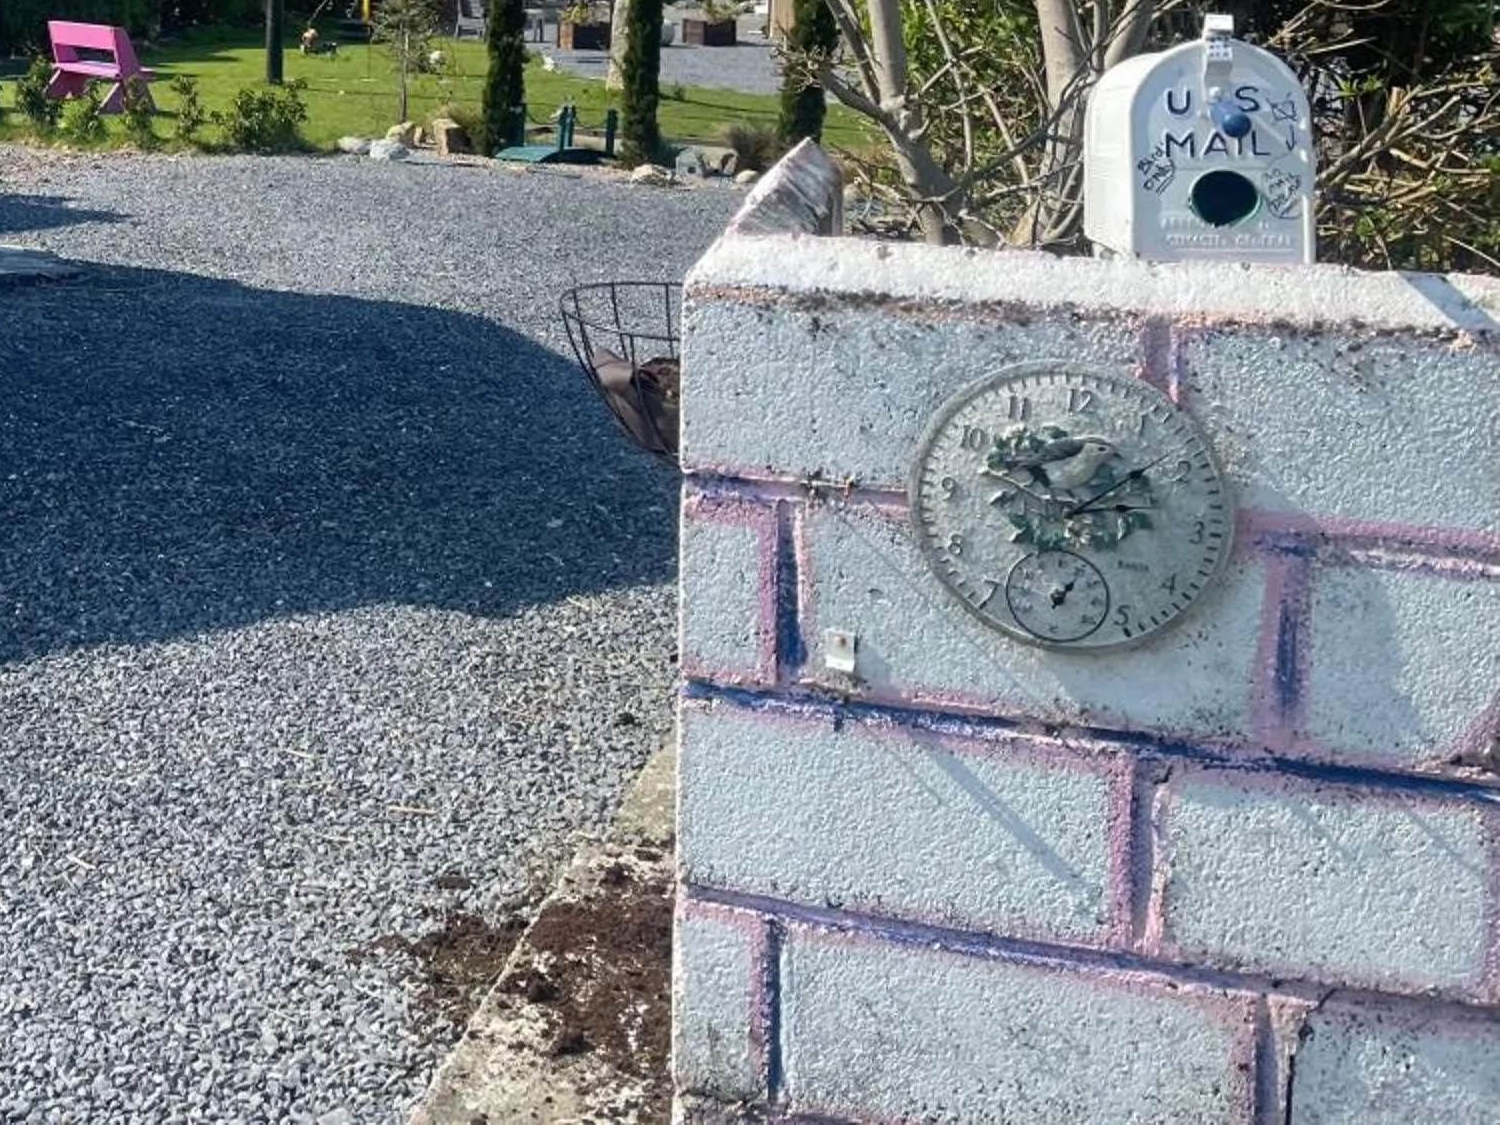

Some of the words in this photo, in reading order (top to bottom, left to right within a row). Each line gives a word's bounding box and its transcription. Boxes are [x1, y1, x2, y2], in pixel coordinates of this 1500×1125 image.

[1165, 129, 1271, 158] MAIL
[1008, 395, 1032, 421] 11
[1067, 388, 1094, 412] 12
[960, 425, 984, 451] 10
[1172, 460, 1192, 484] 2
[942, 477, 956, 501] 9
[948, 533, 963, 556] 8
[1189, 520, 1204, 545] 3
[980, 577, 1001, 610] 7
[1160, 573, 1176, 595] 4
[1114, 604, 1131, 626] 5
